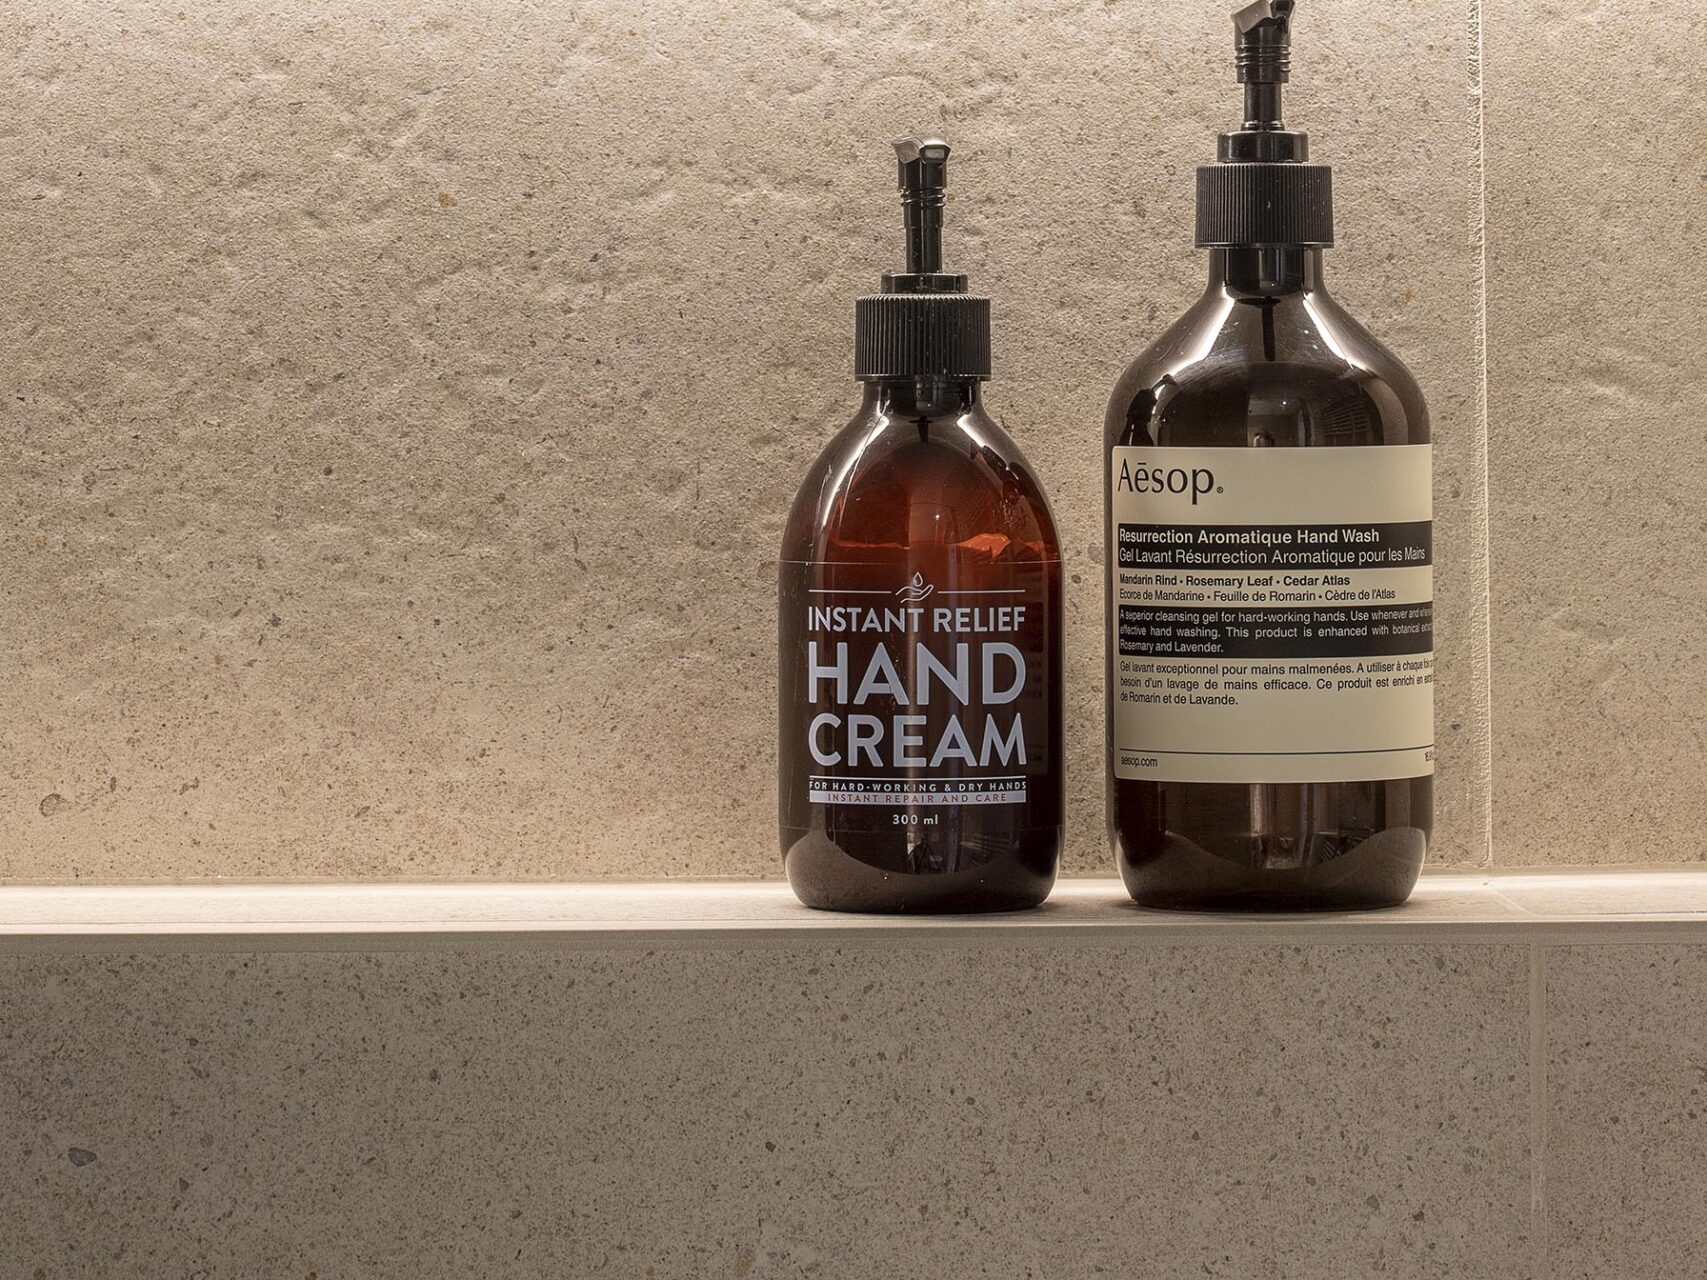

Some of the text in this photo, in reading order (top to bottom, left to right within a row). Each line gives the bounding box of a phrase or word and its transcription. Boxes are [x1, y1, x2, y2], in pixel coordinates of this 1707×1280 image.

[1120, 528, 1379, 547] Resurrection Aromatique Hand Wash
[1120, 547, 1425, 566] Gel Lavant Résurrection Aromatique pour les Mains
[1120, 574, 1350, 588] Mandarin Rind Rosemary Leaf Cedar Atlas
[1143, 590, 1153, 600] de
[1155, 591, 1204, 601] Mandarine
[1214, 591, 1248, 601] Feuille
[1252, 591, 1266, 601] de
[1270, 591, 1316, 601] Romarin
[1325, 590, 1355, 600] Cèdre
[1358, 590, 1370, 599] de
[1372, 589, 1395, 599] l'Atlas
[809, 607, 1026, 632] INSTANT RELIEF
[1120, 610, 1124, 619] A
[1125, 610, 1153, 621] superior
[1156, 611, 1199, 623] cleansing
[1203, 612, 1218, 623] gel
[1221, 612, 1235, 622] for
[1239, 612, 1310, 624] hard-working
[1314, 612, 1348, 621] hands.
[1351, 611, 1369, 620] Use
[1372, 610, 1408, 620] whenever
[1409, 608, 1419, 618] and
[1120, 625, 1146, 634] effective
[1151, 627, 1171, 636] hand
[1177, 627, 1221, 639] washing.
[1226, 627, 1249, 637] This
[1256, 626, 1297, 640] product
[1303, 627, 1312, 637] is
[1318, 626, 1367, 637] enhanced
[1372, 625, 1388, 634] with
[1392, 623, 1419, 634] botanical
[1120, 639, 1223, 653] Rosemary and Lavender.
[809, 641, 1026, 705] HAND
[1120, 661, 1130, 671] Gel
[1132, 662, 1154, 672] lavant
[1156, 663, 1218, 676] exceptionnel
[1222, 665, 1247, 676] pour
[1251, 664, 1285, 675] mains
[1289, 663, 1354, 674] malmenées.
[1357, 663, 1364, 672] A
[1367, 662, 1394, 672] utiliser
[1396, 661, 1401, 671] à
[1121, 676, 1141, 687] besoin
[1145, 678, 1162, 688] d'un
[1167, 678, 1199, 691] lavage
[1205, 679, 1218, 689] de
[1224, 679, 1257, 689] mains
[1264, 679, 1311, 690] efficace.
[1317, 678, 1332, 689] Ce
[1338, 677, 1372, 691] produit
[1376, 677, 1389, 687] est
[1392, 674, 1414, 686] enrichi
[1121, 691, 1238, 705] de Romarin et de Lavande.
[809, 712, 1027, 767] CREAM
[1121, 756, 1158, 767] aesop.com
[810, 781, 827, 789] FOR
[833, 782, 937, 792] HARD-WORKING
[959, 783, 983, 791] DRY
[989, 782, 1026, 790] HANDS
[828, 794, 1006, 803] INSTANT REPAIR AND CARE
[893, 814, 938, 824] 300 ml
